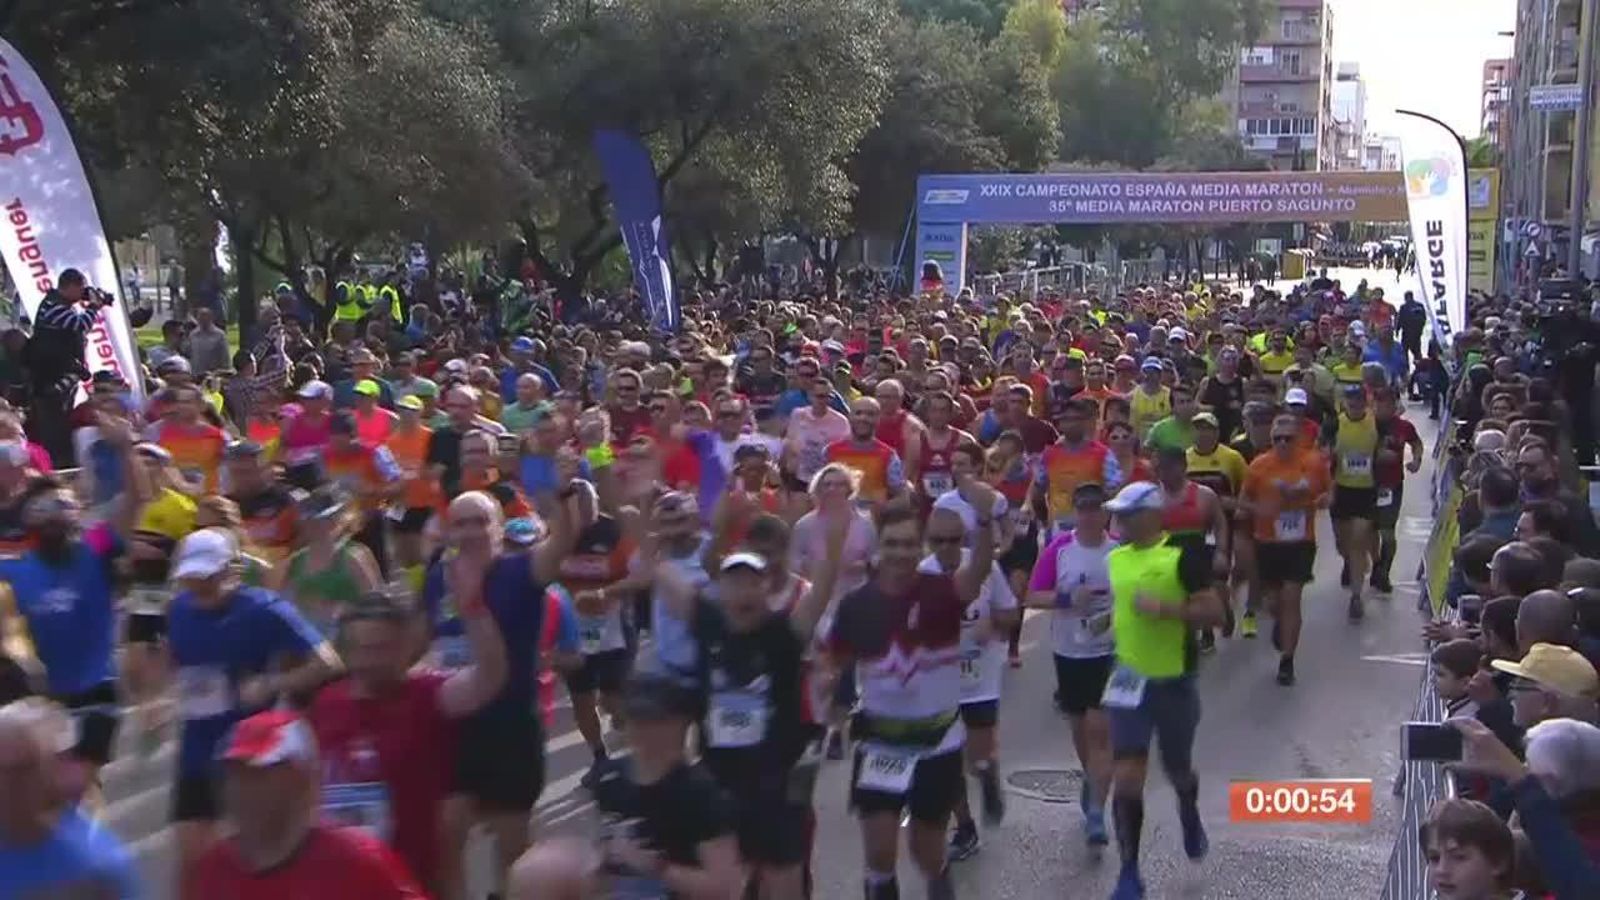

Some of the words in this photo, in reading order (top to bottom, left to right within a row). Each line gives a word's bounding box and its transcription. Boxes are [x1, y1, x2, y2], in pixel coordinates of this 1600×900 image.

[980, 184, 1011, 197] XXIX
[1016, 184, 1120, 197] CAMPEONATO
[1126, 182, 1186, 197] ESPAÑA
[1191, 184, 1240, 197] MEDIA
[1245, 183, 1323, 196] MARATON
[1076, 200, 1125, 213] MEDIA
[1129, 200, 1204, 213] MARATON
[1209, 200, 1272, 212] PUERTO
[1277, 199, 1355, 212] SAGUNTO
